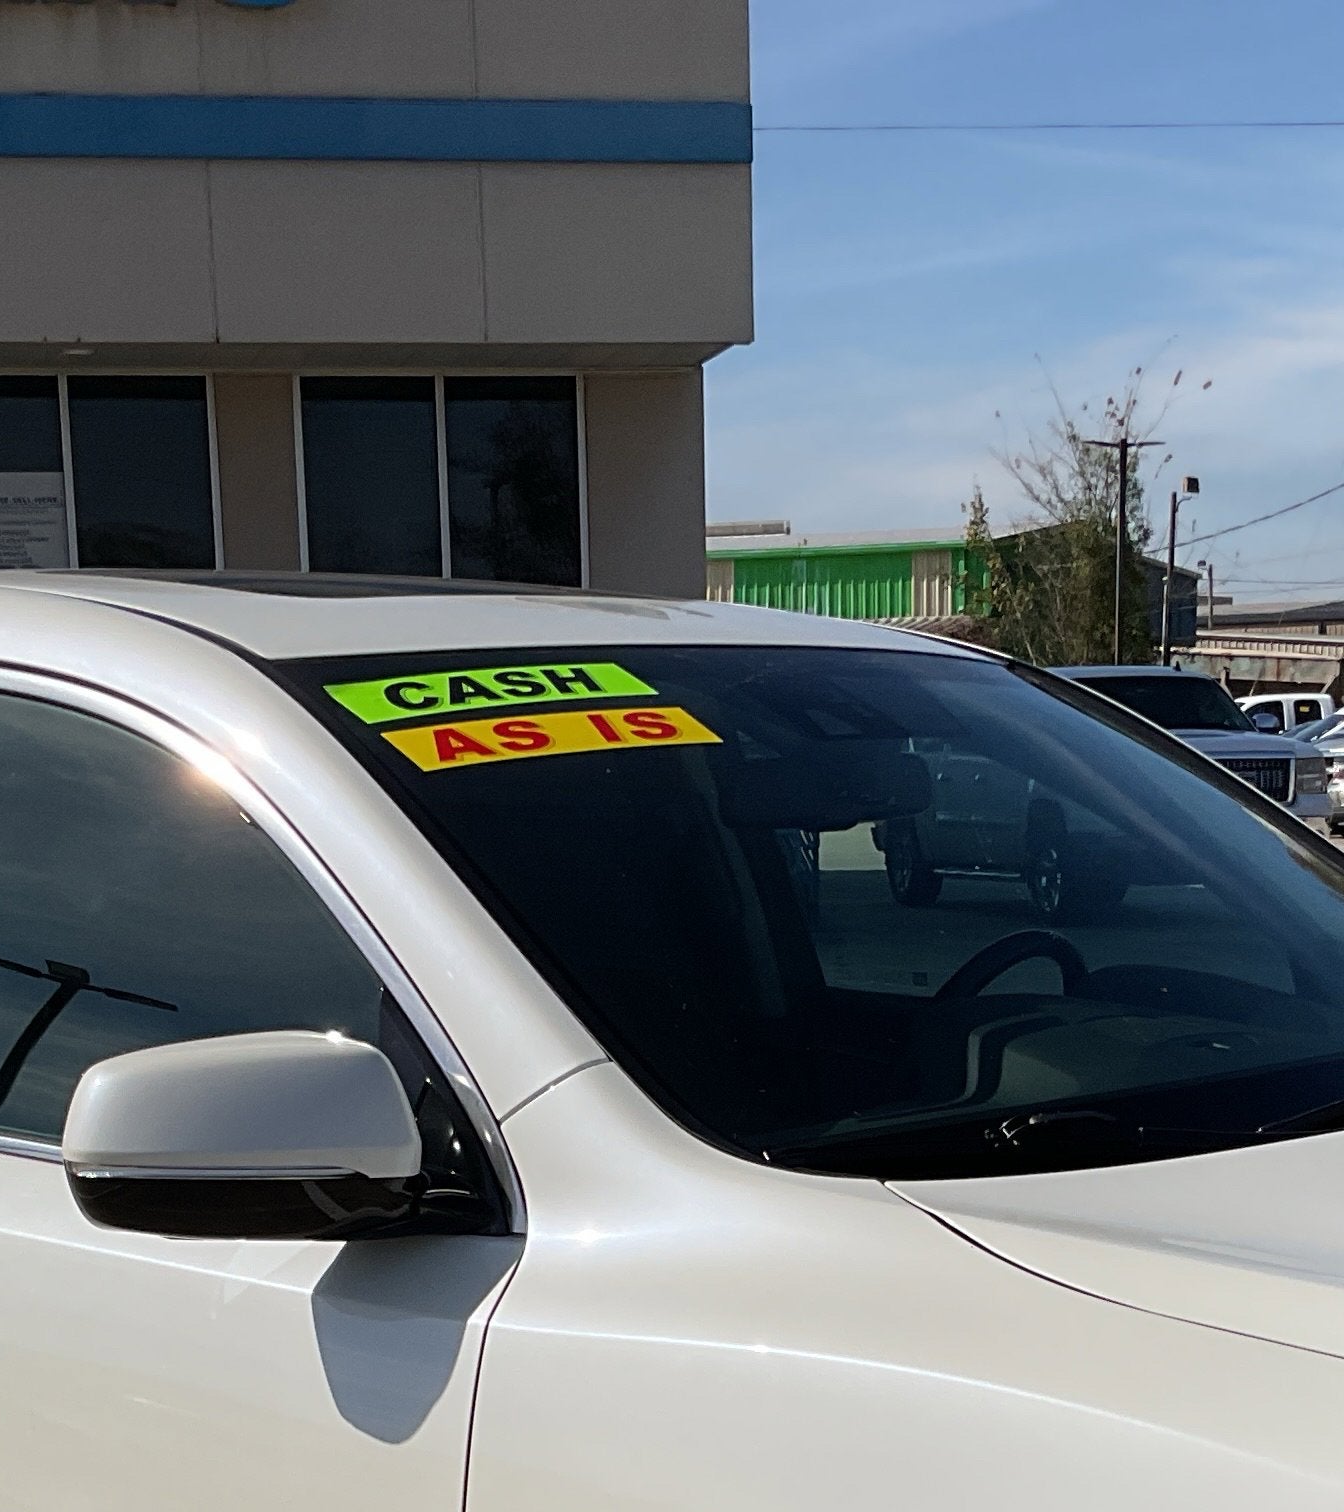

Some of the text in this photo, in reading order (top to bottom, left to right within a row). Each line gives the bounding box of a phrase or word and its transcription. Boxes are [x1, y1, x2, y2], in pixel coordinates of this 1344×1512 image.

[383, 667, 603, 711] CASH
[432, 711, 680, 763] AS IS
